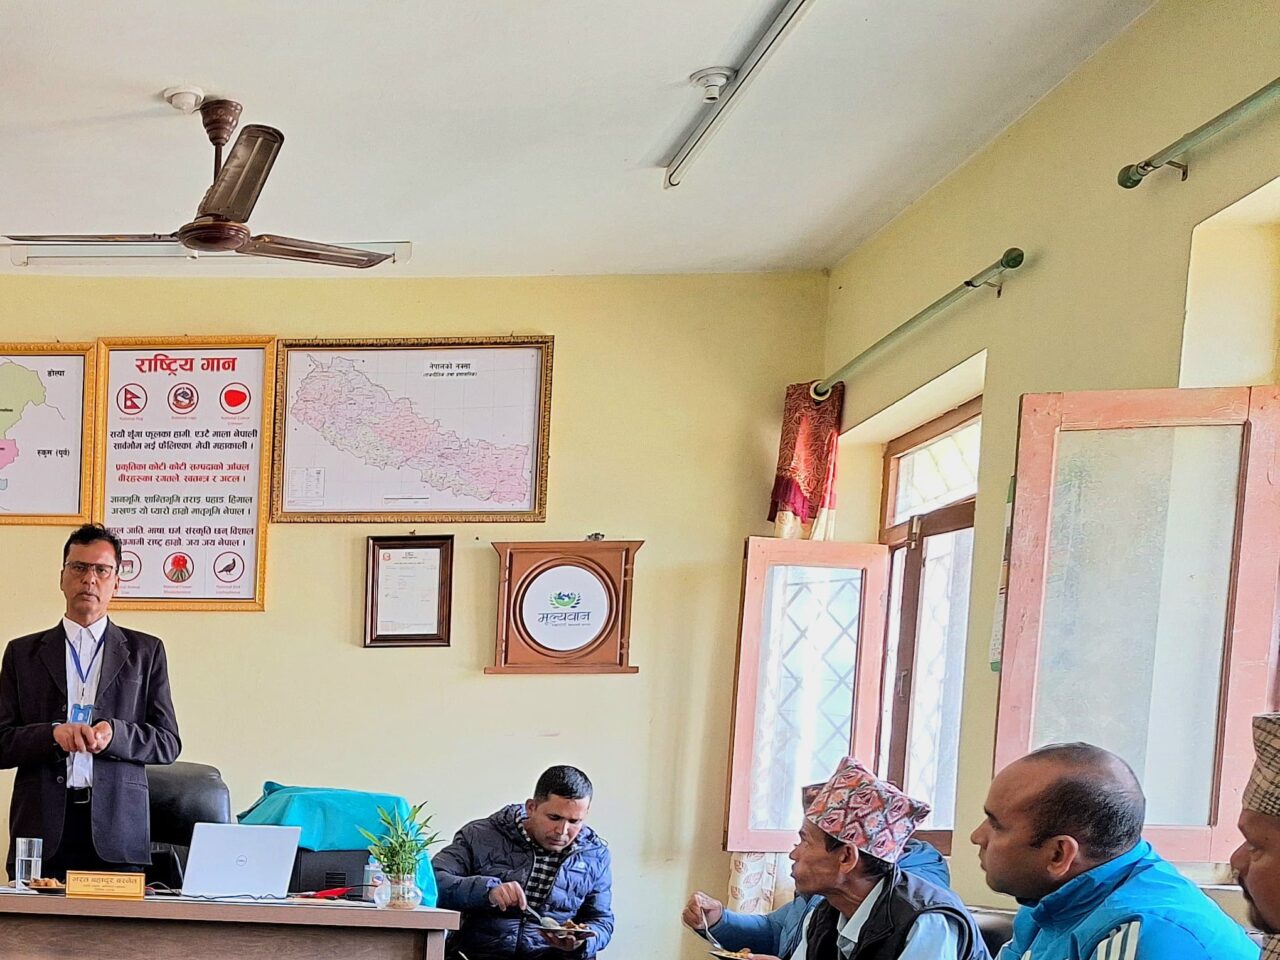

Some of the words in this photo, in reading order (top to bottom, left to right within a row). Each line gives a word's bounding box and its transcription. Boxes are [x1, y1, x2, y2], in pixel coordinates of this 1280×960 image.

[135, 353, 195, 376] राष्ट्रिय
[201, 358, 237, 372] गान
[146, 429, 171, 439] फूलका
[195, 429, 210, 438] एउटै
[212, 430, 230, 438] माला
[234, 429, 258, 438] नेपाली
[195, 441, 210, 450] मेची
[213, 441, 247, 450] महाकाली
[115, 462, 146, 472] प्रकृतिका
[149, 462, 166, 470] कोटी
[169, 462, 186, 470] कोटी
[190, 462, 223, 471] सम्पदाको
[144, 494, 180, 504] शान्तिभूमि
[229, 495, 253, 503] हिमाल
[172, 507, 188, 515] हाम्रो
[191, 507, 220, 516] मातृभूमि
[223, 507, 244, 515] नेपाल
[185, 526, 211, 535] संस्कृति
[230, 526, 254, 535] विशाल
[218, 537, 239, 545] नेपाल
[537, 611, 591, 625] मूल्यवान
